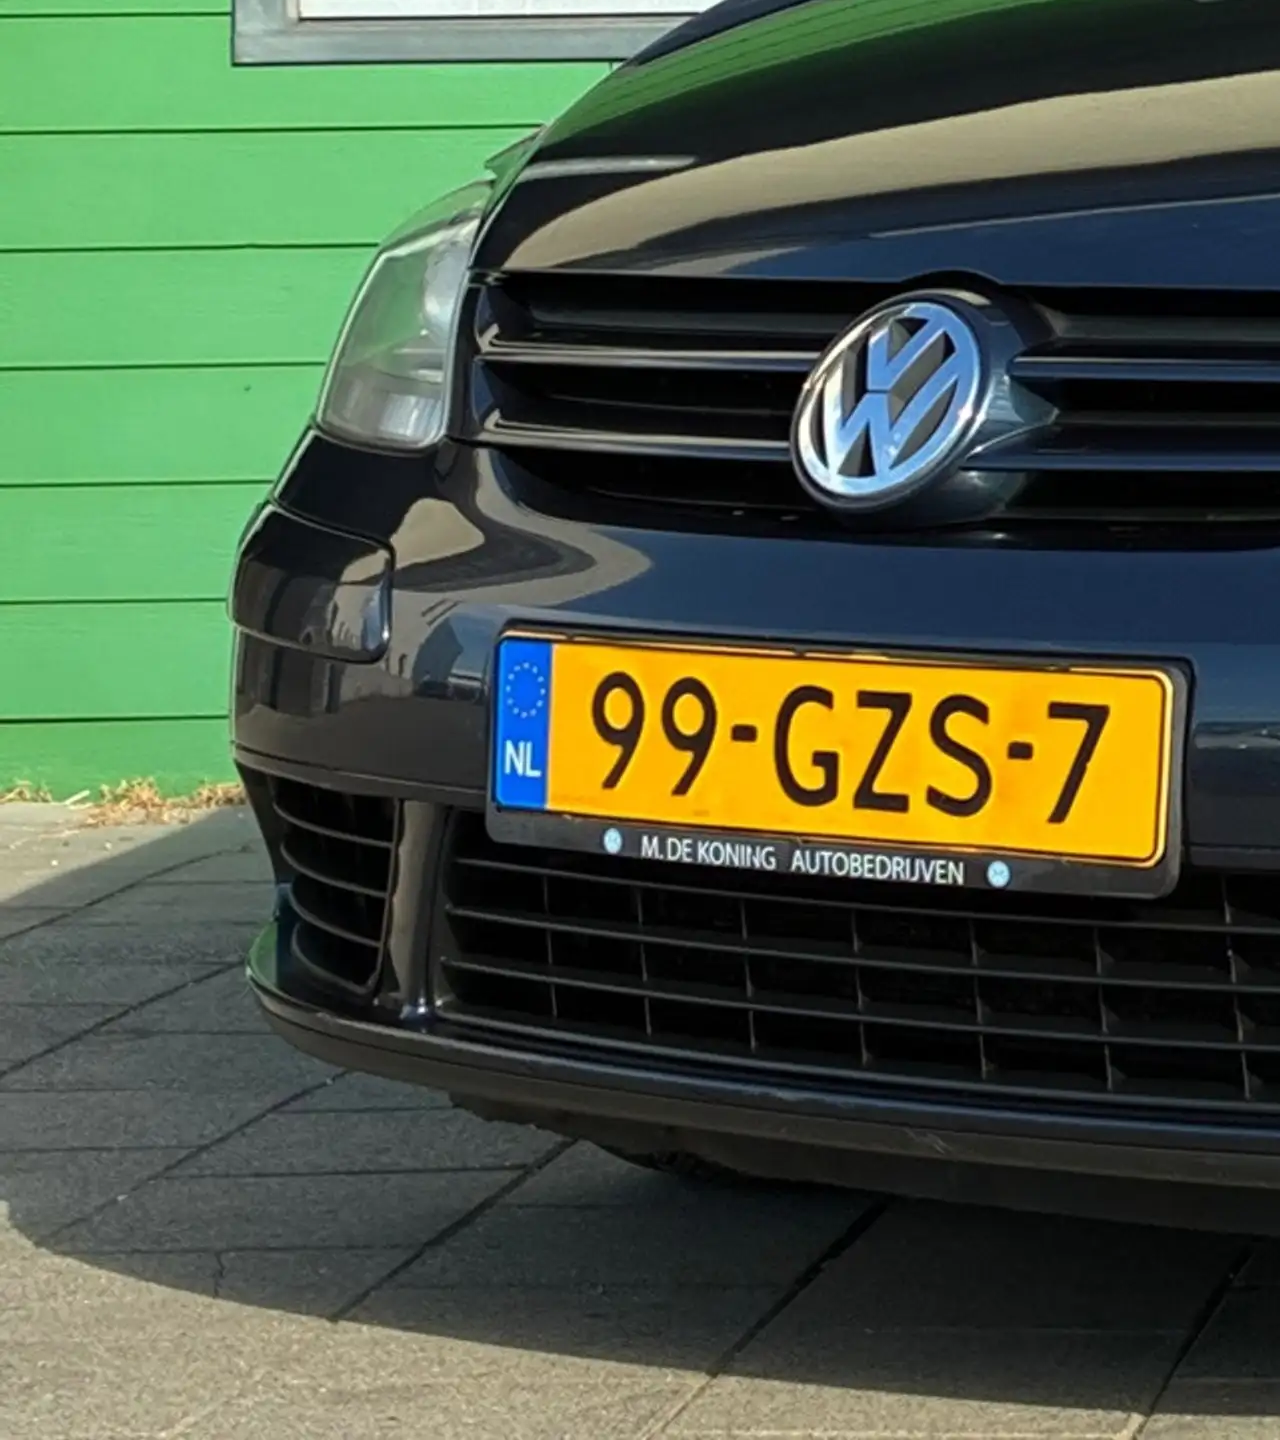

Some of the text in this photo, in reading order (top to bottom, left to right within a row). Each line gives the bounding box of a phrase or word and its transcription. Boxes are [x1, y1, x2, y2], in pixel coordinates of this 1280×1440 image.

[503, 740, 542, 778] NL
[591, 670, 1111, 825] 99-GZS-7
[641, 834, 965, 886] M. DE KONING AUTOBEDRIJVEN
